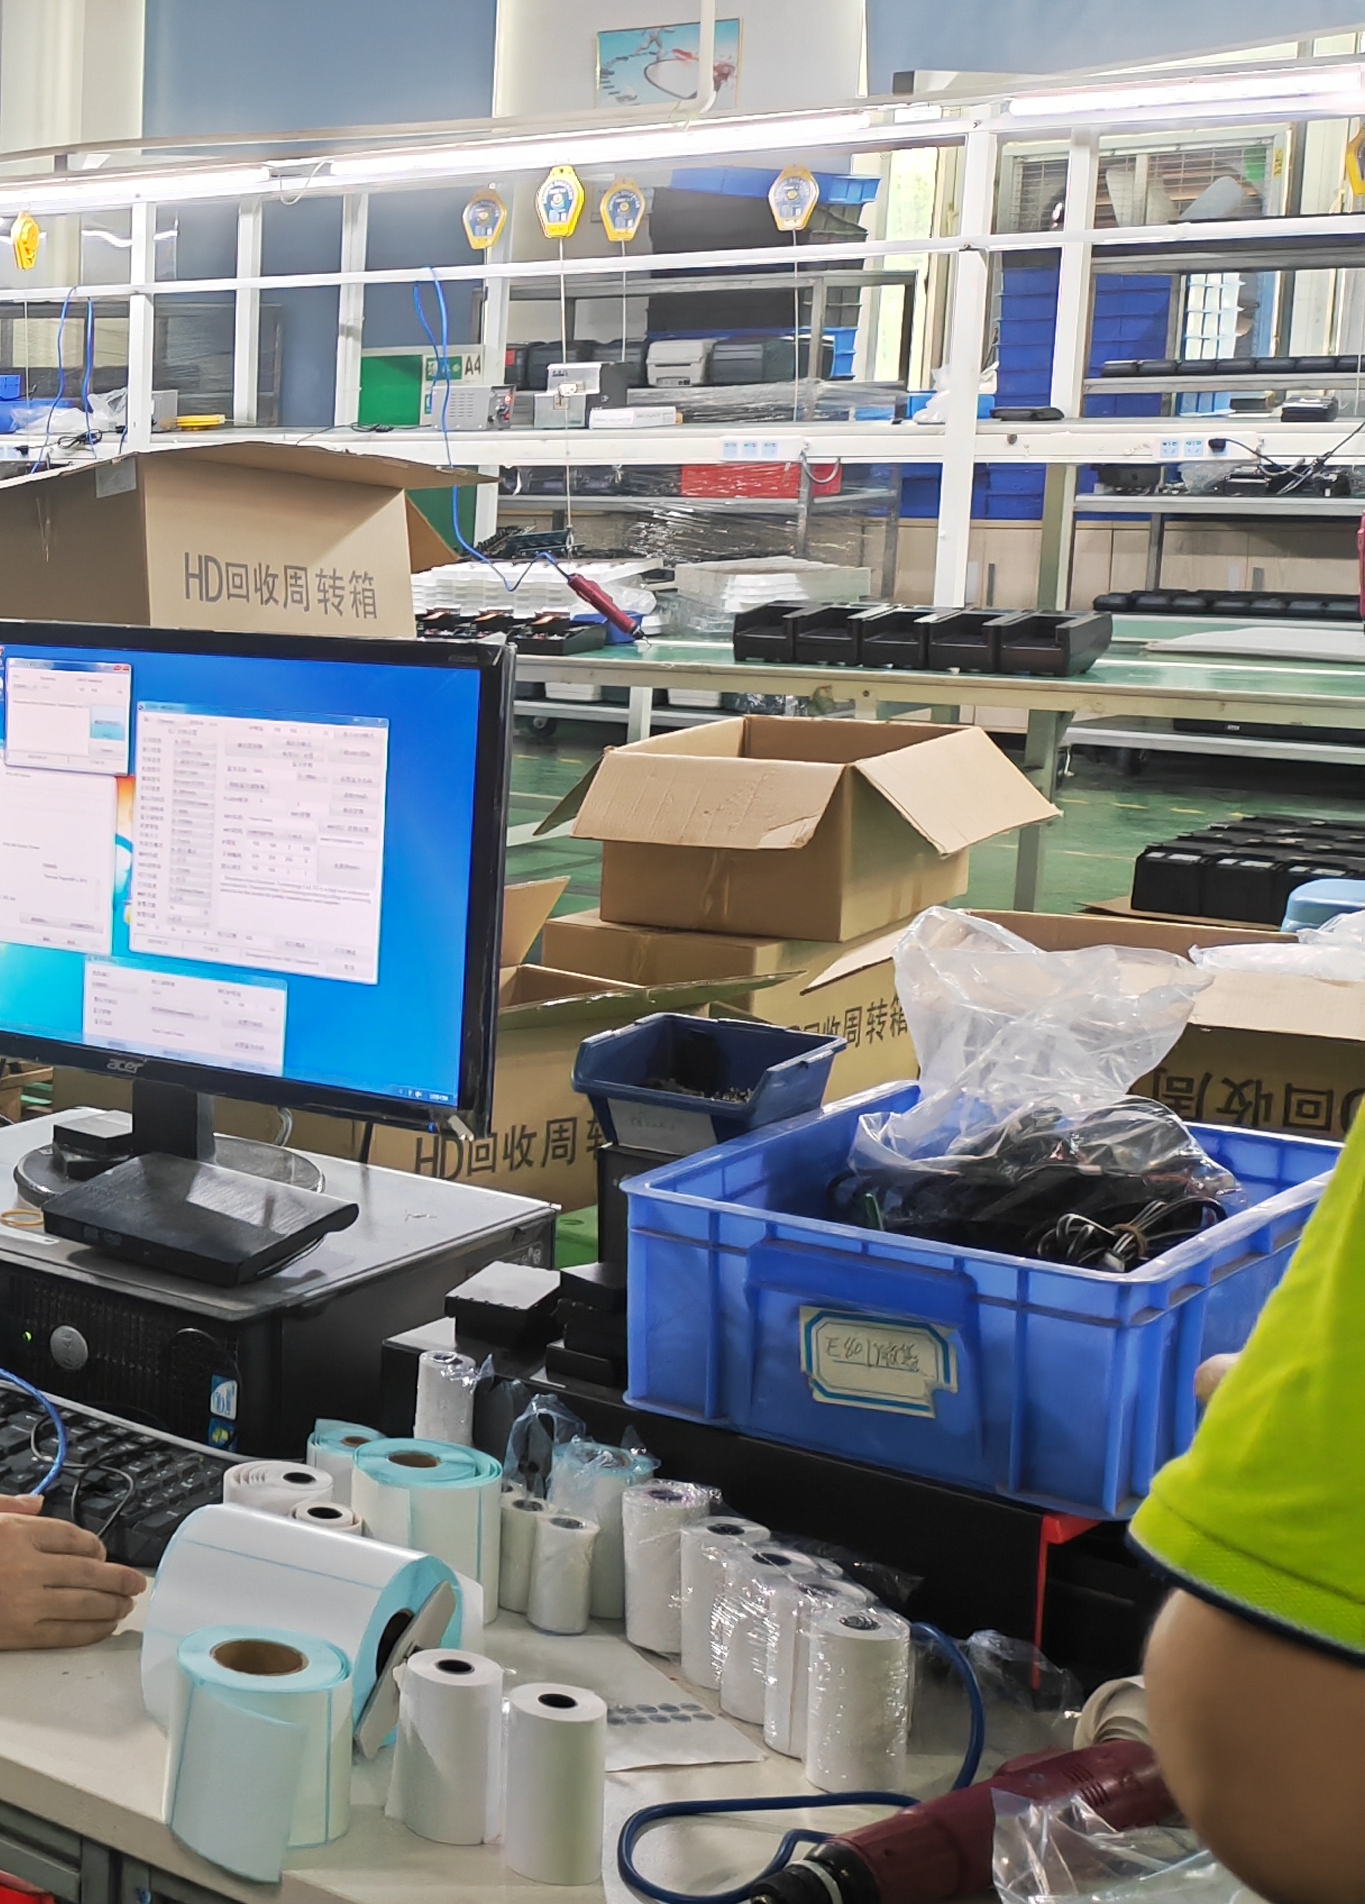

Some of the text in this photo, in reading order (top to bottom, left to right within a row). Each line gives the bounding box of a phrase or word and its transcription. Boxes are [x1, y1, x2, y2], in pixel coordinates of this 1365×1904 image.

[464, 353, 481, 376] A4
[184, 551, 378, 620] HD回收周转箱
[107, 1058, 144, 1075] acer
